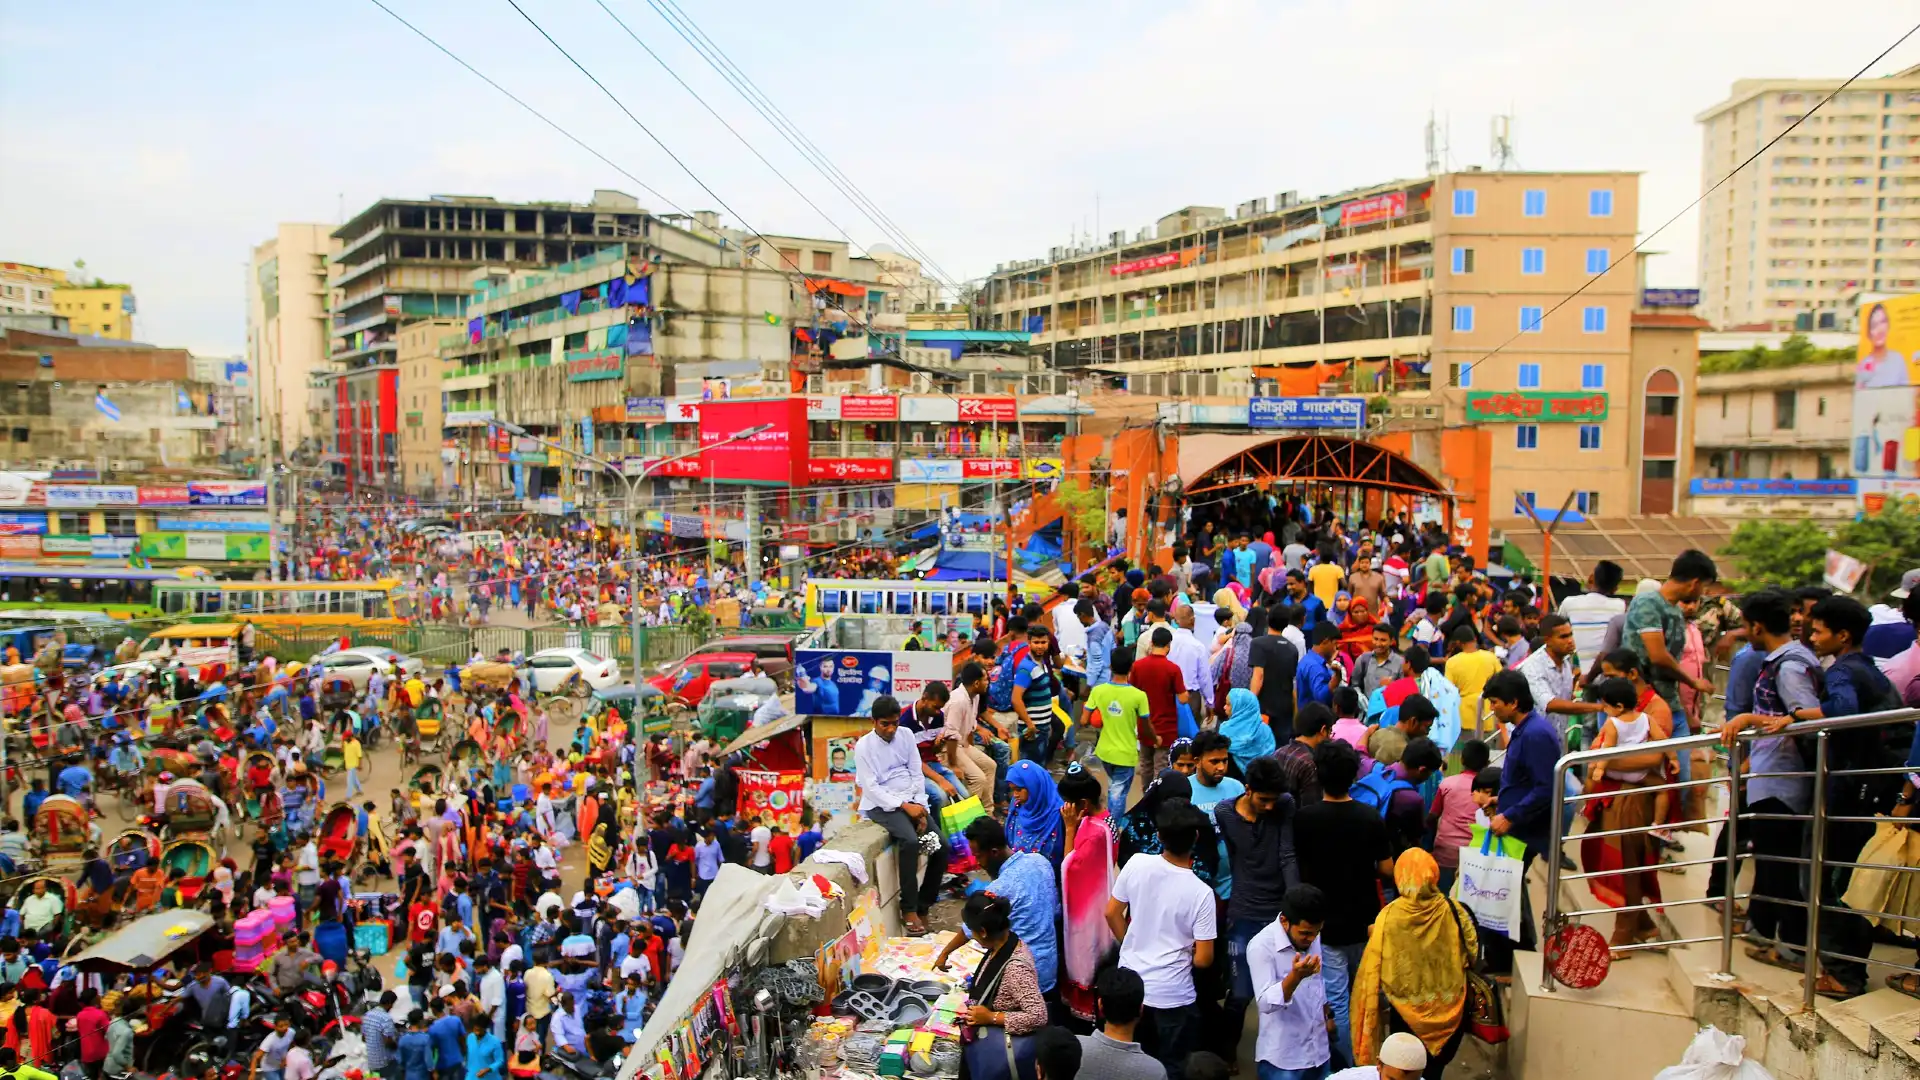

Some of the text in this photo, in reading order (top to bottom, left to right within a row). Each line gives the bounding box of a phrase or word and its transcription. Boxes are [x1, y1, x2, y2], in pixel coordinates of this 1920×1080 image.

[960, 400, 984, 415] RK
[1251, 399, 1298, 416] মৌসুমী
[1549, 395, 1605, 416] মার্কেট
